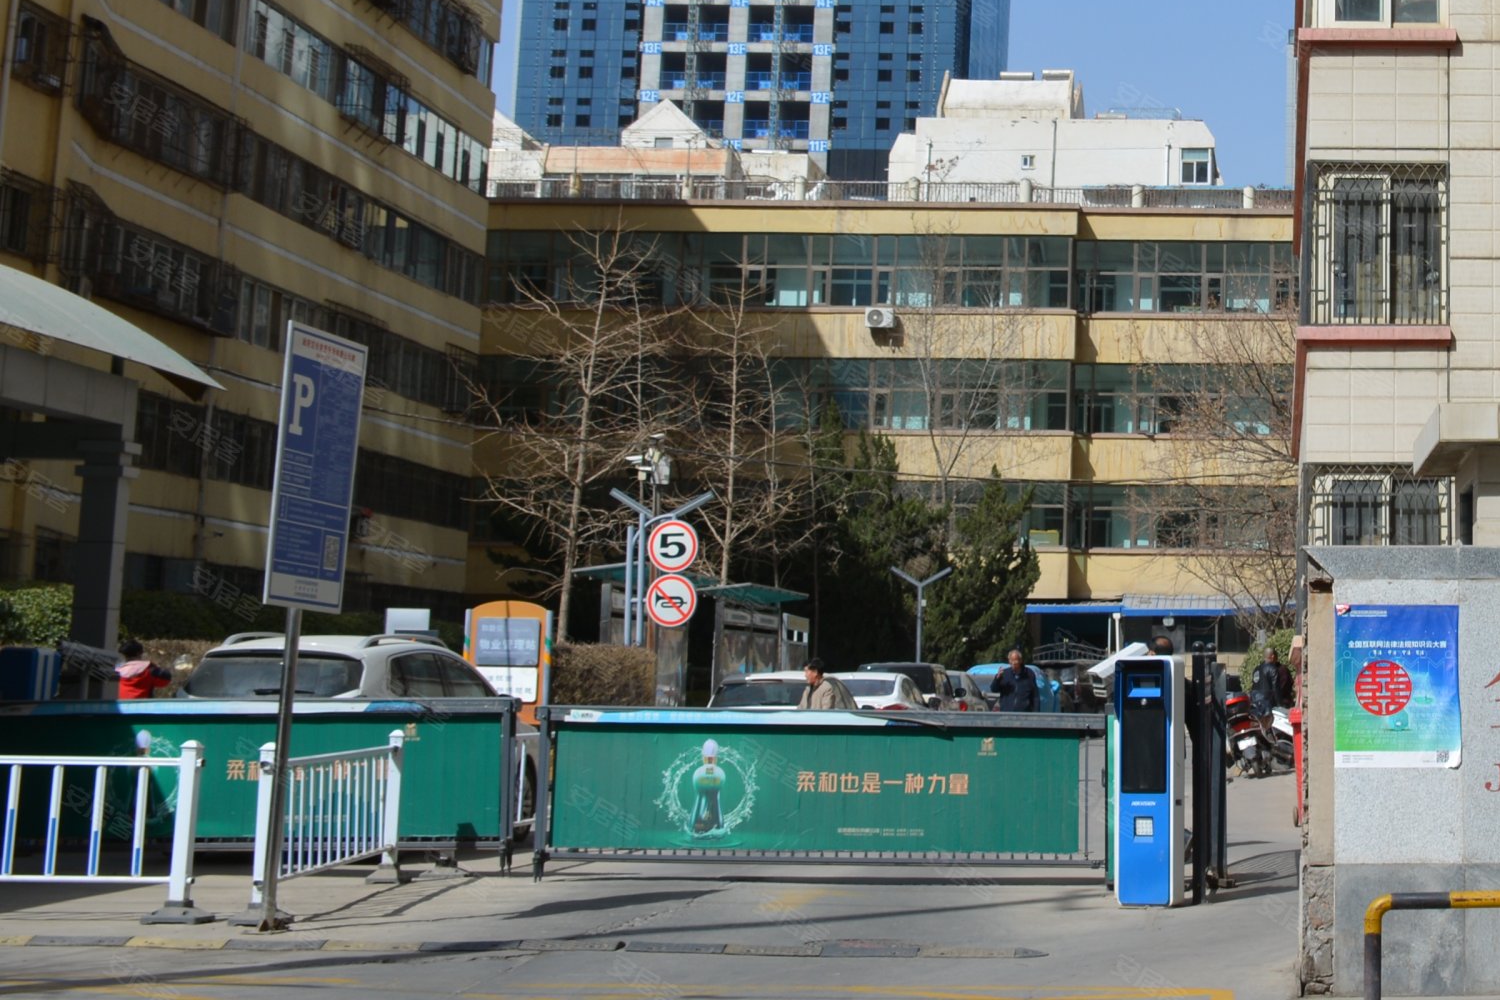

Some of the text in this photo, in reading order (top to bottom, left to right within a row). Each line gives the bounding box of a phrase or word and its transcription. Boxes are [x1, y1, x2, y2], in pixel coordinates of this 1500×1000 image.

[644, 43, 661, 52] 13F
[729, 44, 747, 54] 13F
[814, 45, 831, 54] 13F
[641, 91, 658, 100] 12F
[727, 92, 744, 101] 12F
[812, 93, 829, 102] 12F
[810, 141, 827, 150] 11F
[288, 373, 315, 436] P
[659, 532, 687, 558] 5
[796, 770, 970, 796] 柔和也是一种力量
